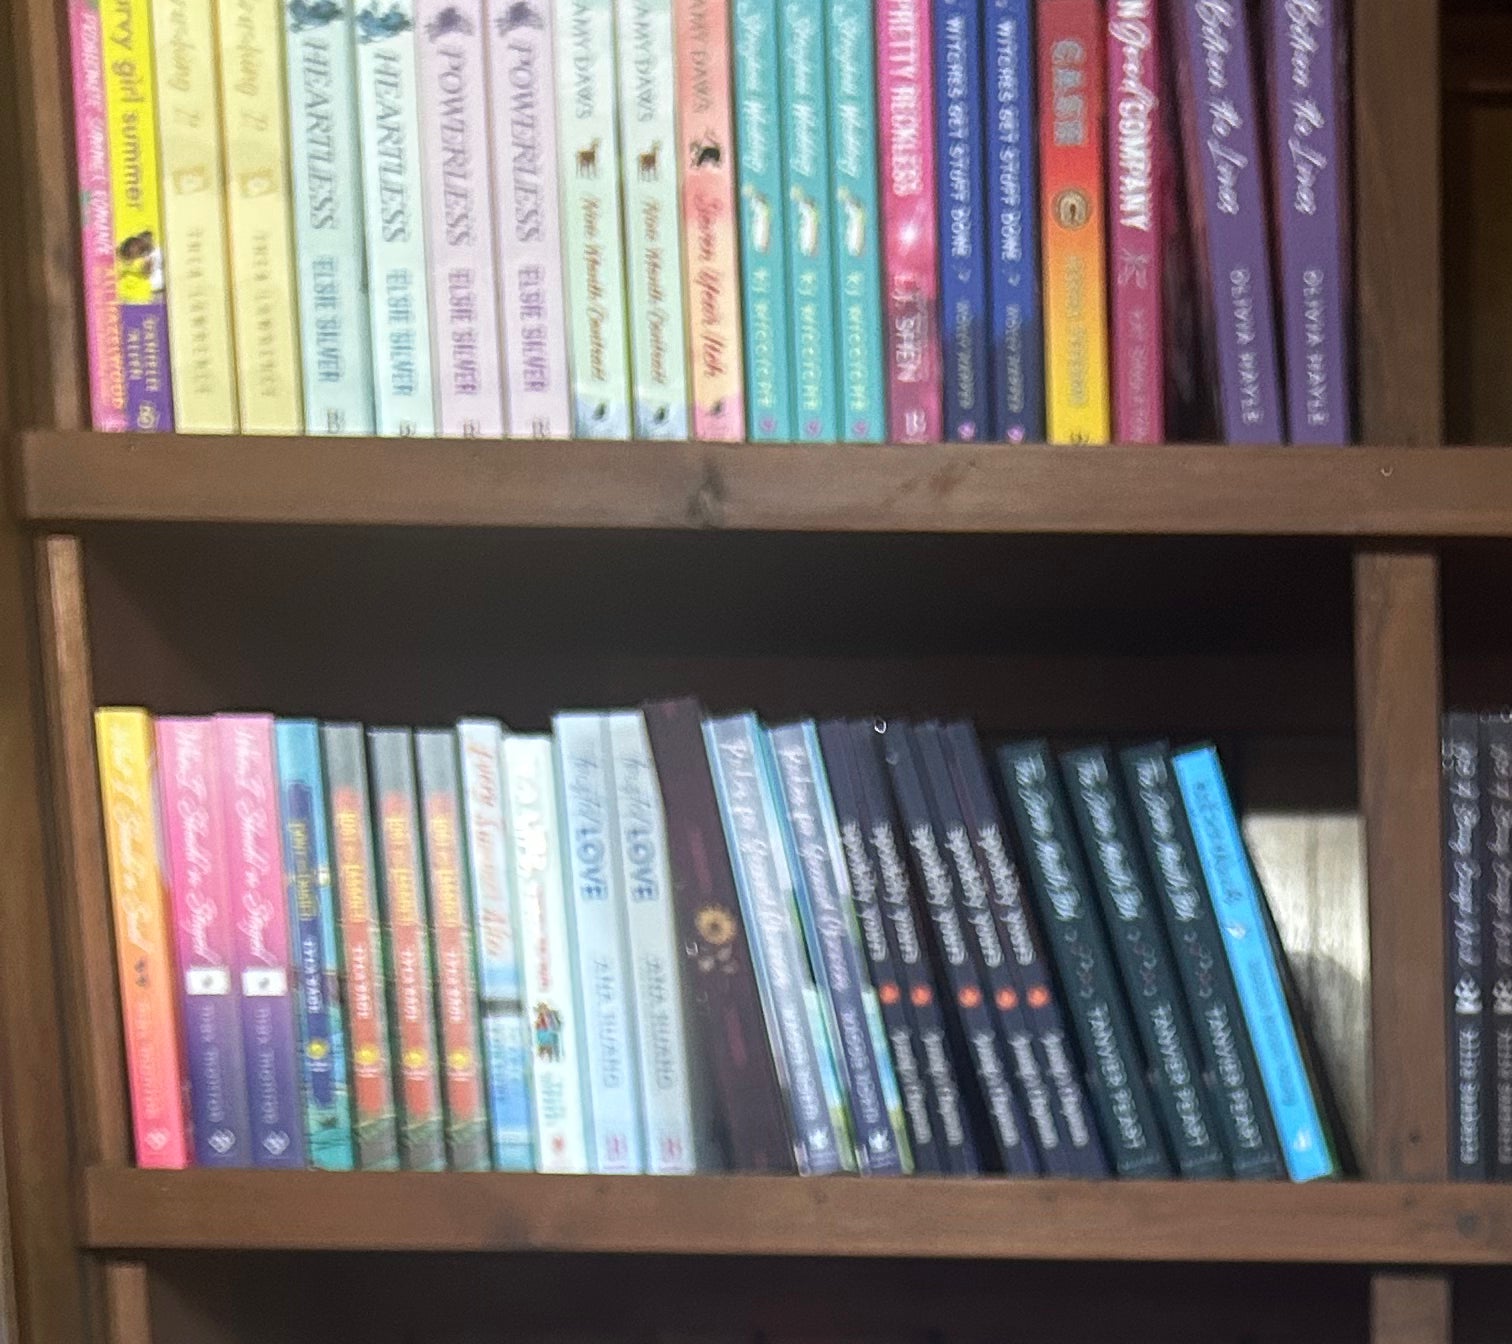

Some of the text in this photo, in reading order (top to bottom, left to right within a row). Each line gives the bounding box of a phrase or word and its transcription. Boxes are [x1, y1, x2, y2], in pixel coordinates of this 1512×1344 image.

[946, 17, 968, 98] WITCHES
[996, 21, 1018, 102] WITCHES
[1052, 38, 1089, 147] CASH
[112, 60, 147, 212] girl summer
[302, 40, 339, 231] HEARTLESS
[373, 51, 411, 244] HEARTLESS
[437, 47, 472, 247] POWERLESS
[507, 41, 544, 243] POWERLESS
[890, 85, 922, 196] RECKLESS
[1118, 101, 1153, 231] COMPANY
[573, 827, 607, 902] LOVE
[625, 827, 659, 903] LOVE
